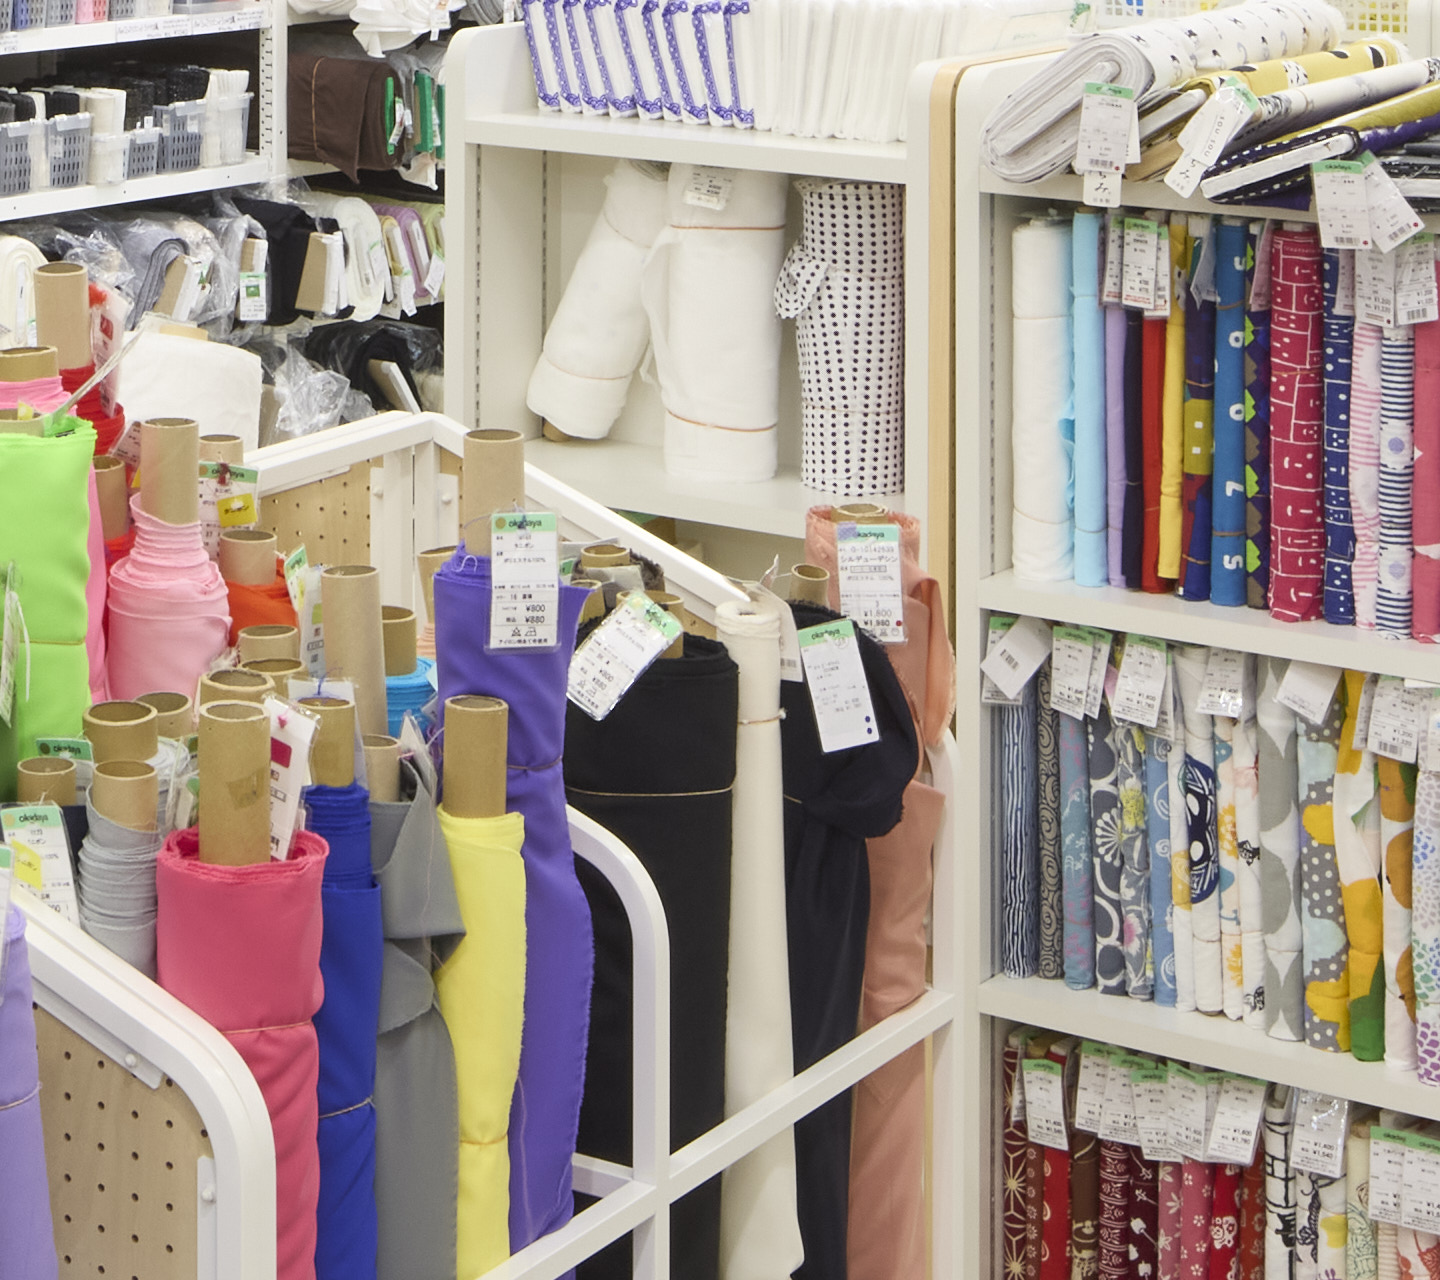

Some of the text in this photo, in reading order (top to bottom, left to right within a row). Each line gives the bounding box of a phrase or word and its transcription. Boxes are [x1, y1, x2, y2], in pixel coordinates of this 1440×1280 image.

[857, 530, 885, 539] kadaya
[526, 605, 545, 613] ¥800
[864, 609, 892, 617] ¥1,800
[525, 616, 545, 624] ¥880
[863, 619, 891, 627] ¥1,980
[1313, 1149, 1334, 1159] ¥1,540
